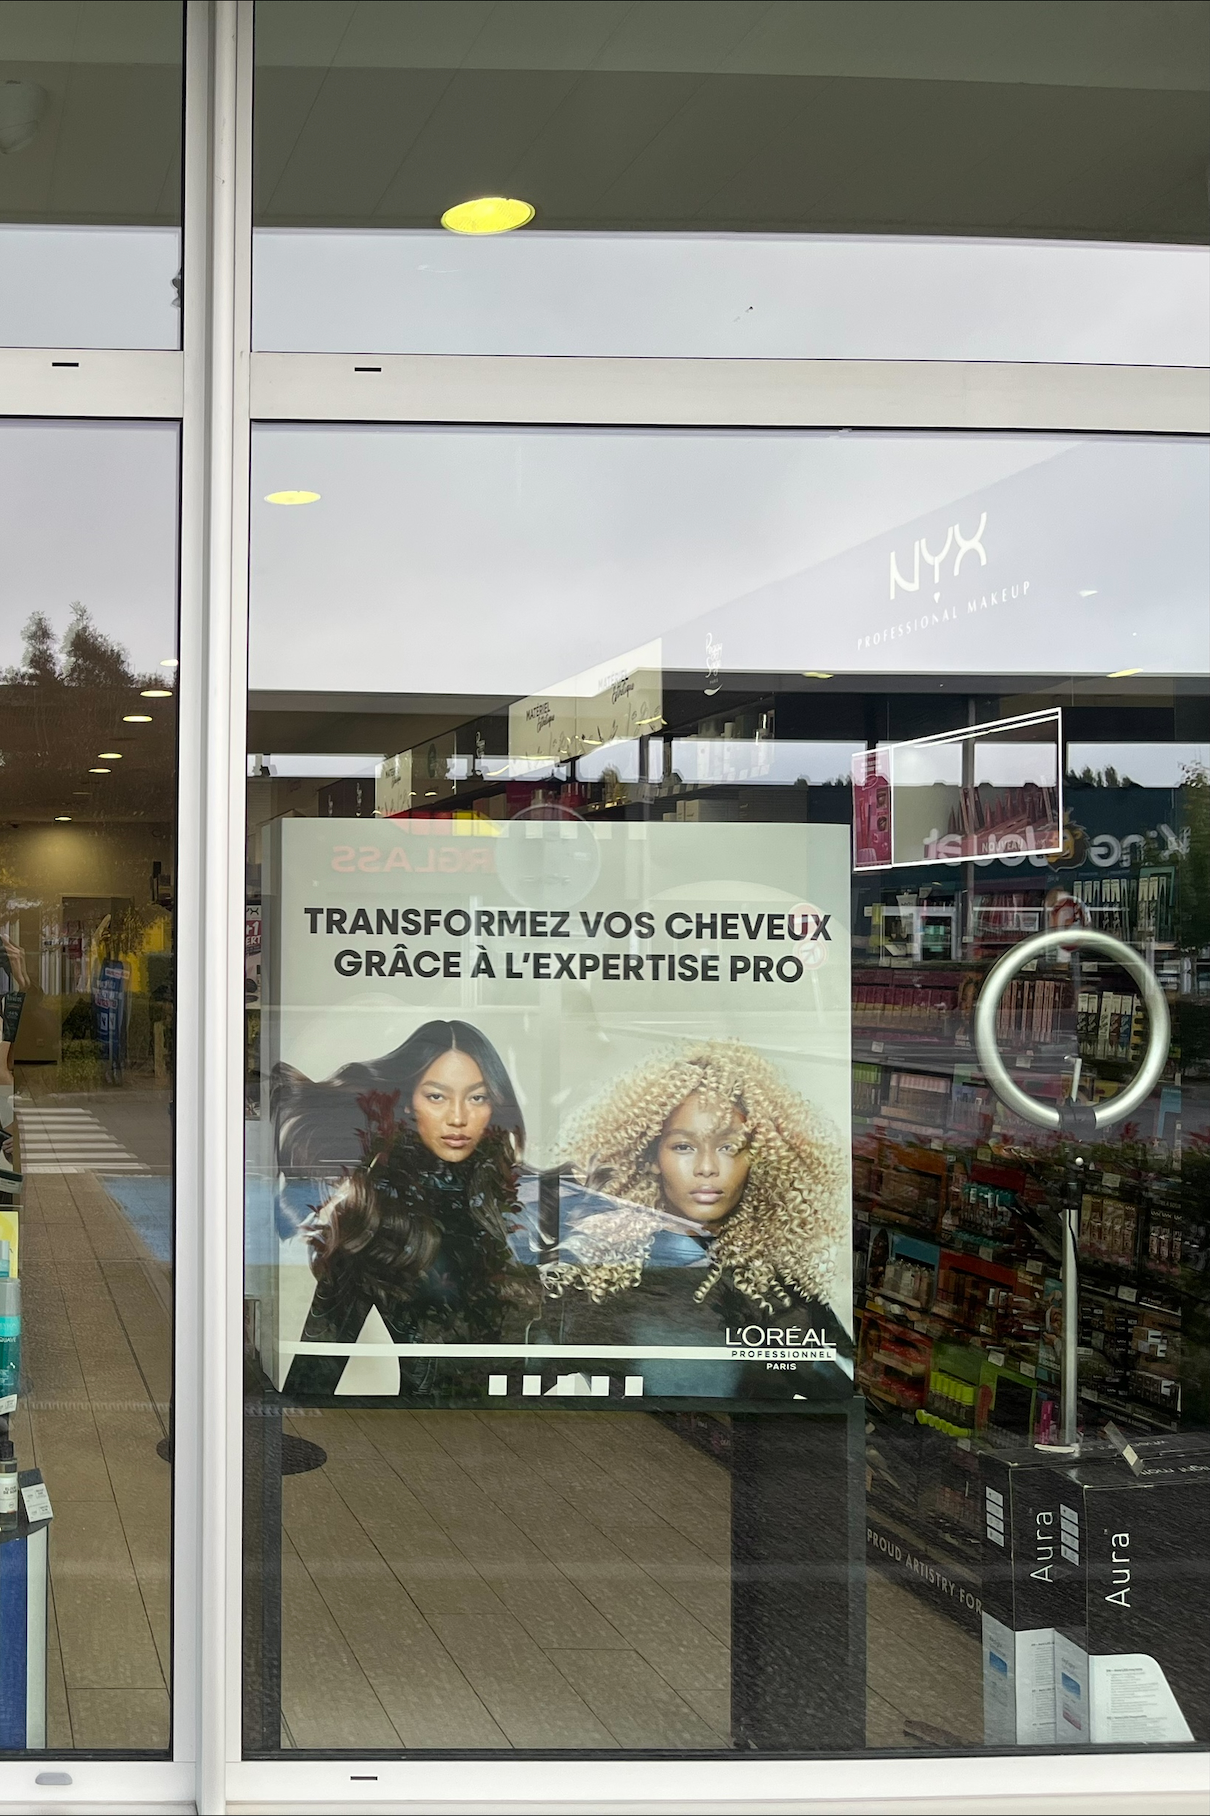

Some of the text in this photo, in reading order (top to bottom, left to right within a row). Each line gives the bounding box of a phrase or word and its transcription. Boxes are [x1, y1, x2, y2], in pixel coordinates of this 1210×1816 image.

[889, 511, 987, 600] NYX
[857, 580, 1030, 651] PROFESSIONAL MAKEUP
[525, 701, 551, 722] MATÉRIEL
[304, 907, 832, 941] TRANSFORMEZ VOS CHEVEUX
[334, 943, 804, 983] GRÂCE À L'EXPERTISE PRO
[725, 1324, 837, 1346] L'ORÉAL
[731, 1350, 832, 1358] PROFESSIONNEL
[766, 1362, 797, 1370] PARIS
[1029, 1510, 1053, 1583] Aura
[866, 1527, 983, 1616] PROUD ARTISTRY FOR
[1104, 1531, 1131, 1608] Aura
